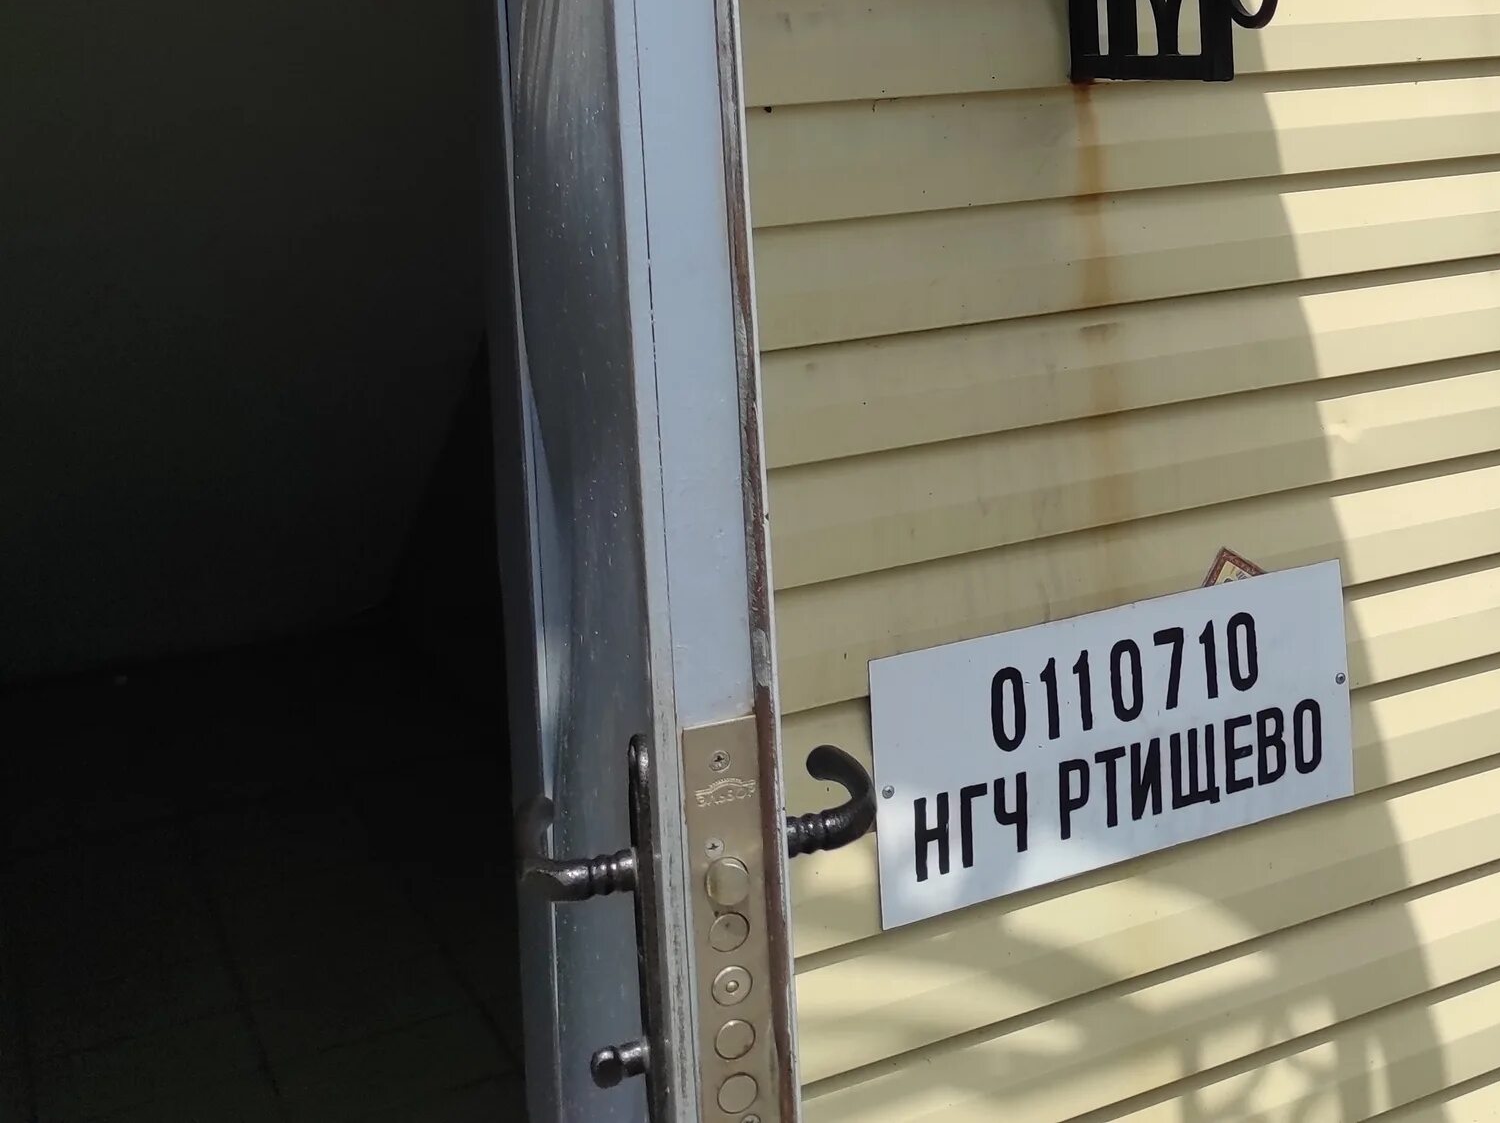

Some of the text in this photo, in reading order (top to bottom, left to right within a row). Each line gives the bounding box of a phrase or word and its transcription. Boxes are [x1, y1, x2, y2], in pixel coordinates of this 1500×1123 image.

[991, 612, 1258, 752] 0110710
[914, 699, 1322, 882] НГЧ РТИЩЕВО
